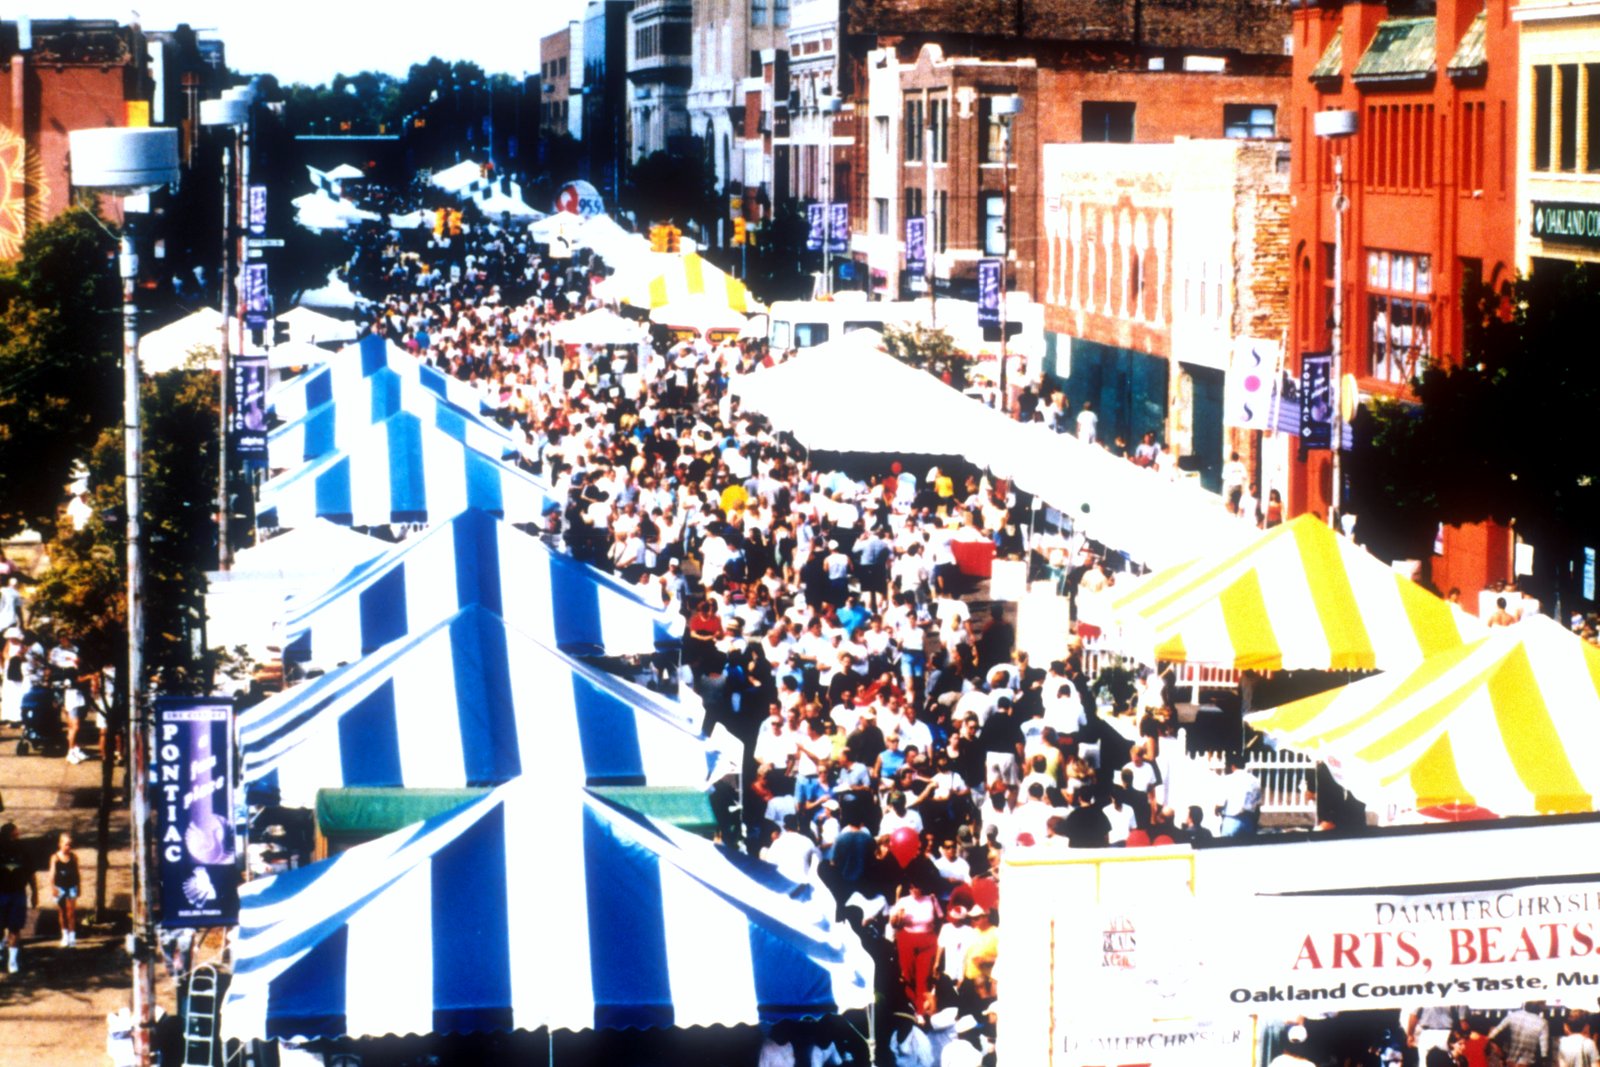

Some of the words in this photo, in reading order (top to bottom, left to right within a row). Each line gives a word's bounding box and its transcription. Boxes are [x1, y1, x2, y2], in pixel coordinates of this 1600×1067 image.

[1545, 208, 1585, 235] OAKLAND
[1587, 210, 1600, 237] CO
[235, 367, 244, 430] PONTIAC
[161, 724, 182, 863] PONTIAC
[1292, 931, 1432, 973] ARTS,
[1229, 983, 1346, 1003] Oakland
[1351, 978, 1470, 998] County's
[1472, 975, 1548, 991] Taste,
